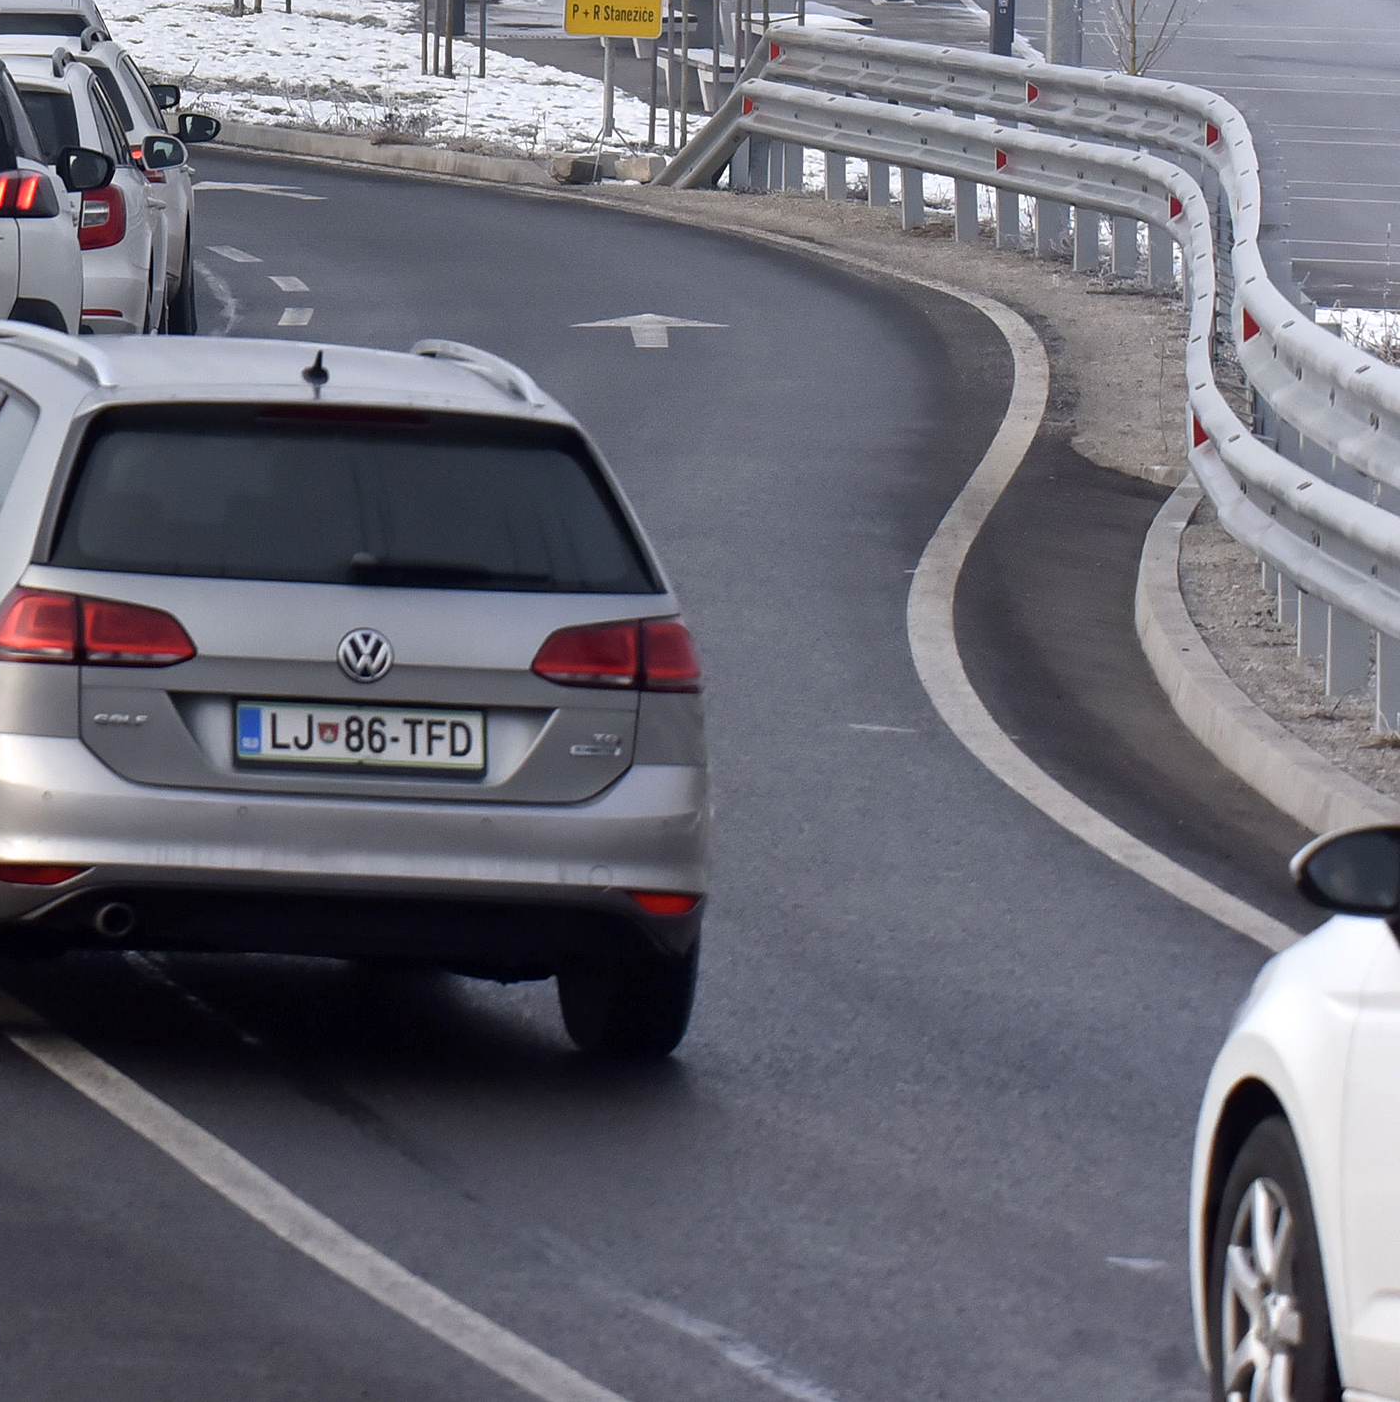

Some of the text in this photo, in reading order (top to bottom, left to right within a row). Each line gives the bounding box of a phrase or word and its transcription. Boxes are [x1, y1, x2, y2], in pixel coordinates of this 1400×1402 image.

[572, 4, 654, 23] P + R Stanežiče
[271, 712, 472, 757] LJ 86-TFD
